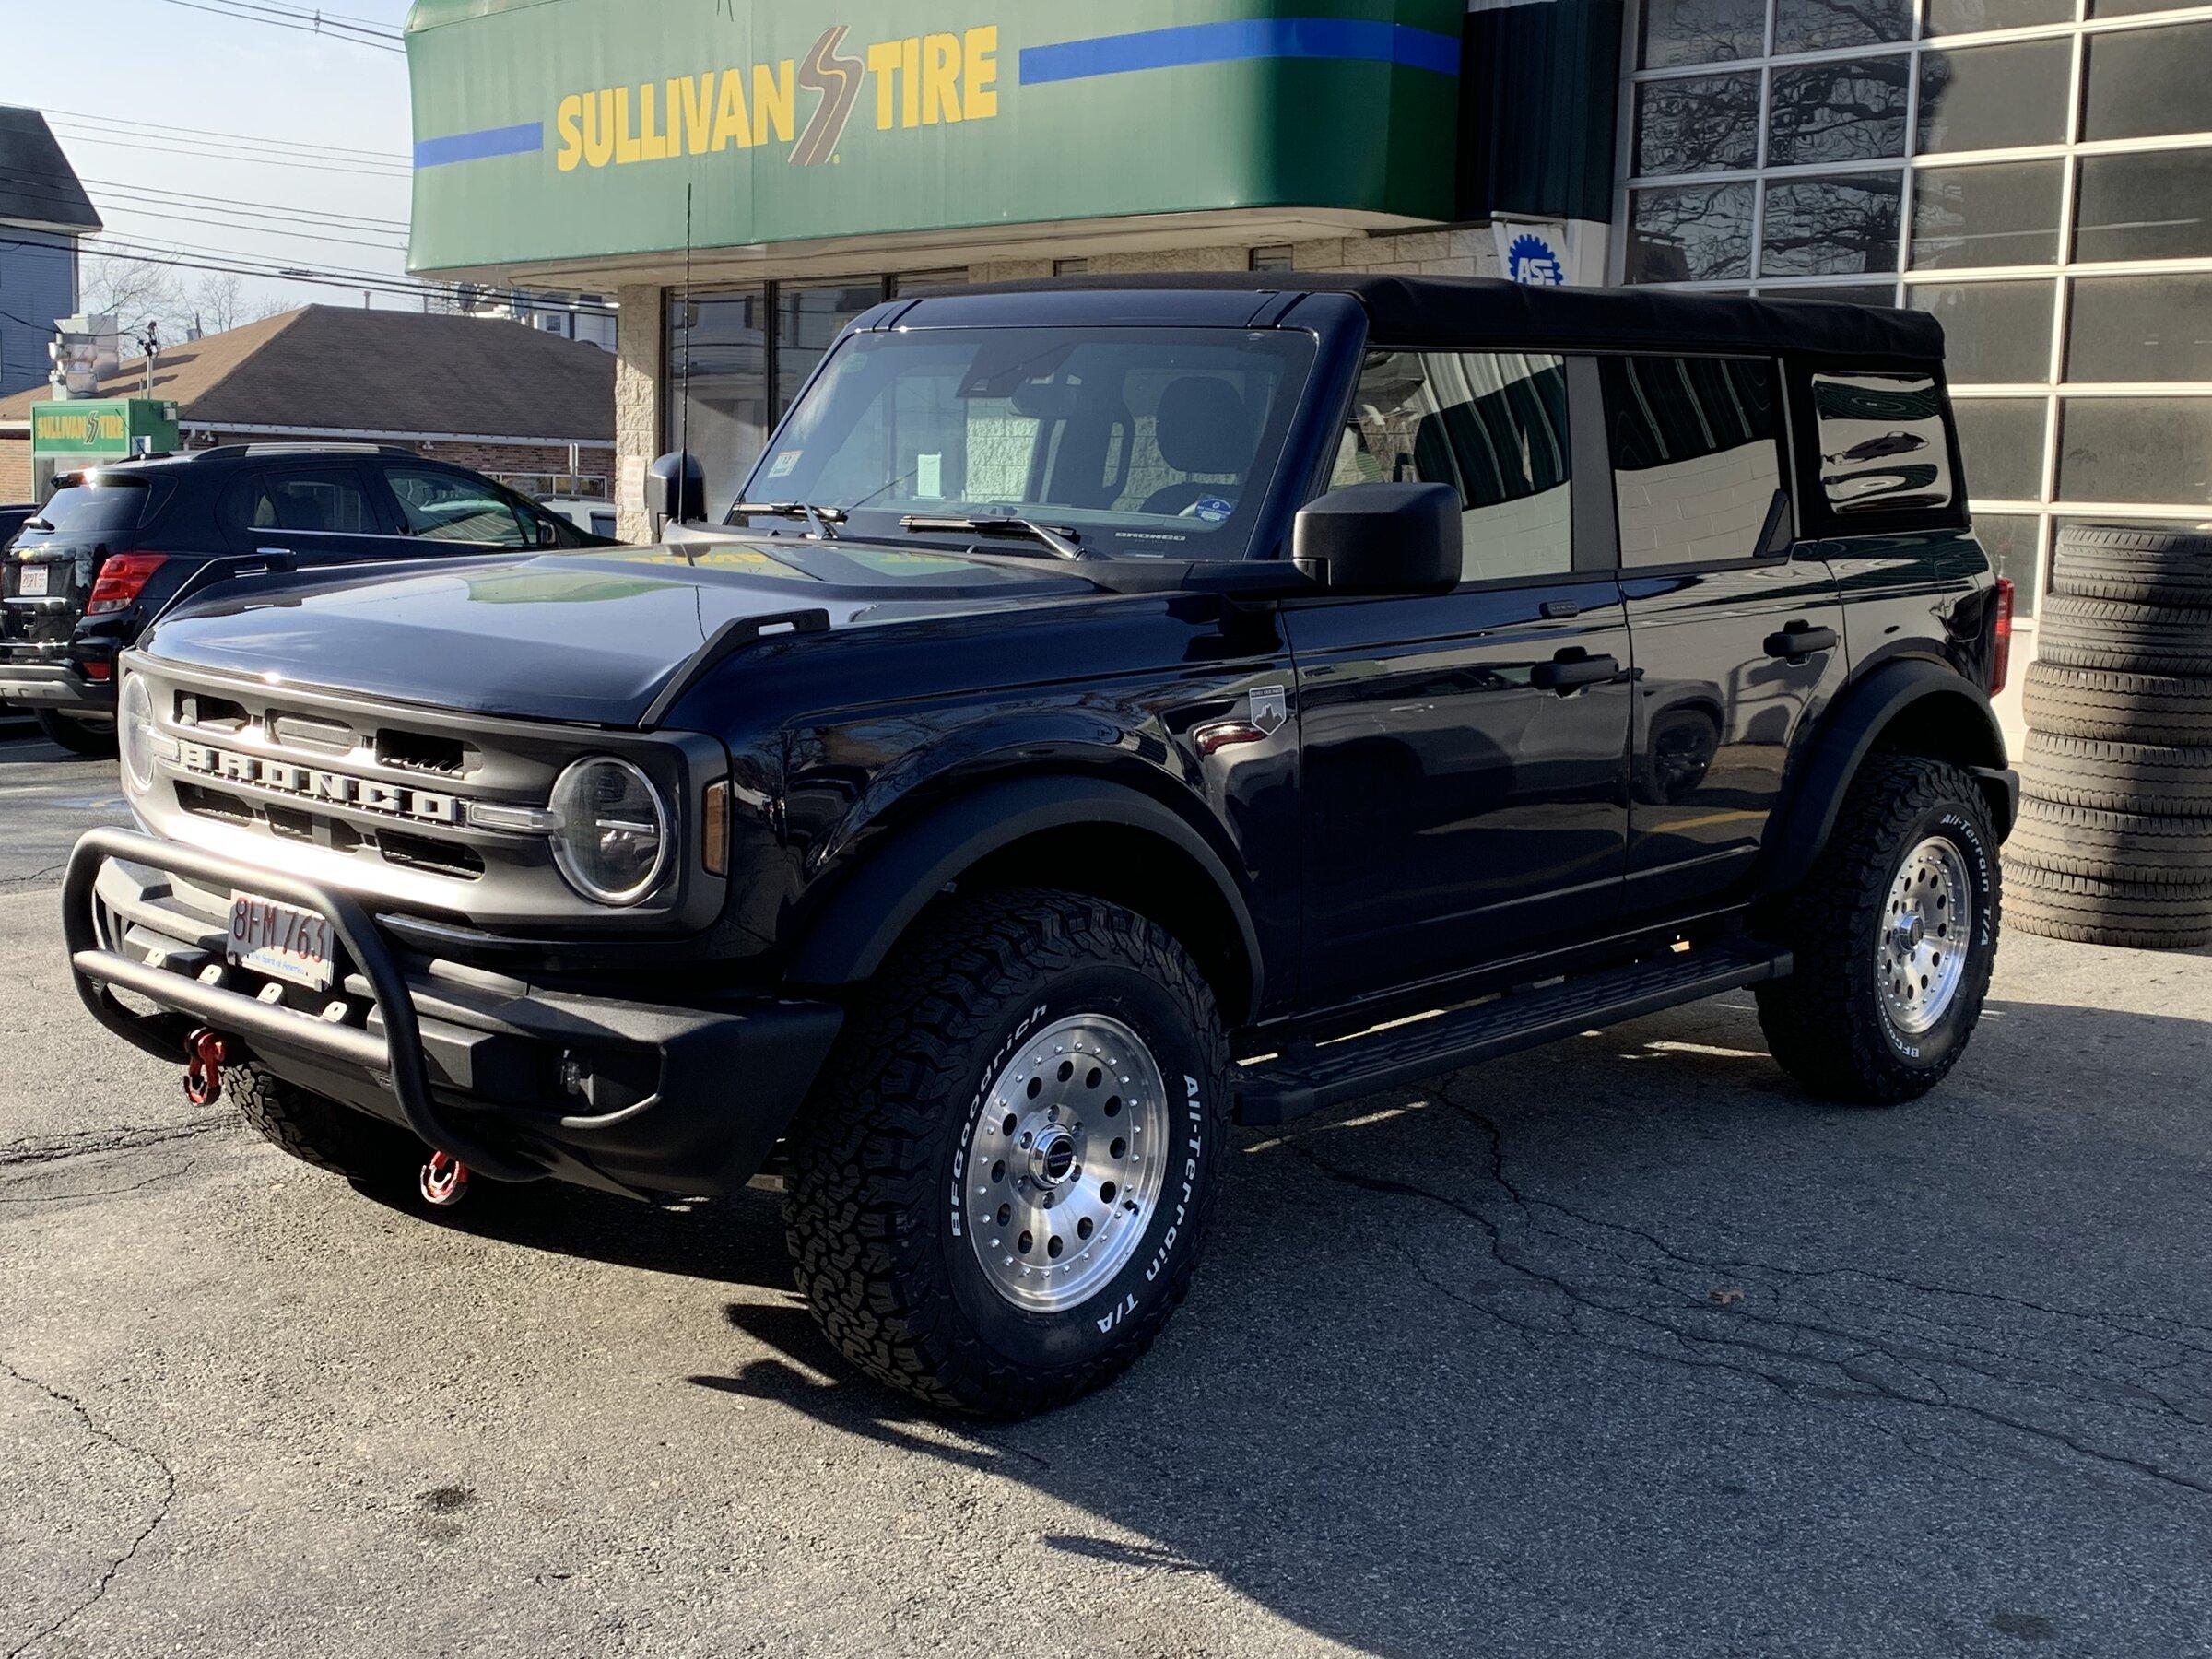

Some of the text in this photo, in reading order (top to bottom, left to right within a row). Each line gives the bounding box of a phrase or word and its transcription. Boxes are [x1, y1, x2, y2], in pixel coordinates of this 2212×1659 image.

[557, 24, 998, 171] SULLIVAN TIRE
[1517, 257, 1556, 285] ASE
[38, 416, 124, 439] SULLIVAN TIRE
[181, 740, 459, 822] BRONCO
[233, 897, 325, 963] 8FM 763
[1940, 814, 1992, 946] All-Terrain T/A
[951, 1004, 1047, 1236] BFGoodrich
[1097, 1075, 1202, 1332] All-Terrain T/A
